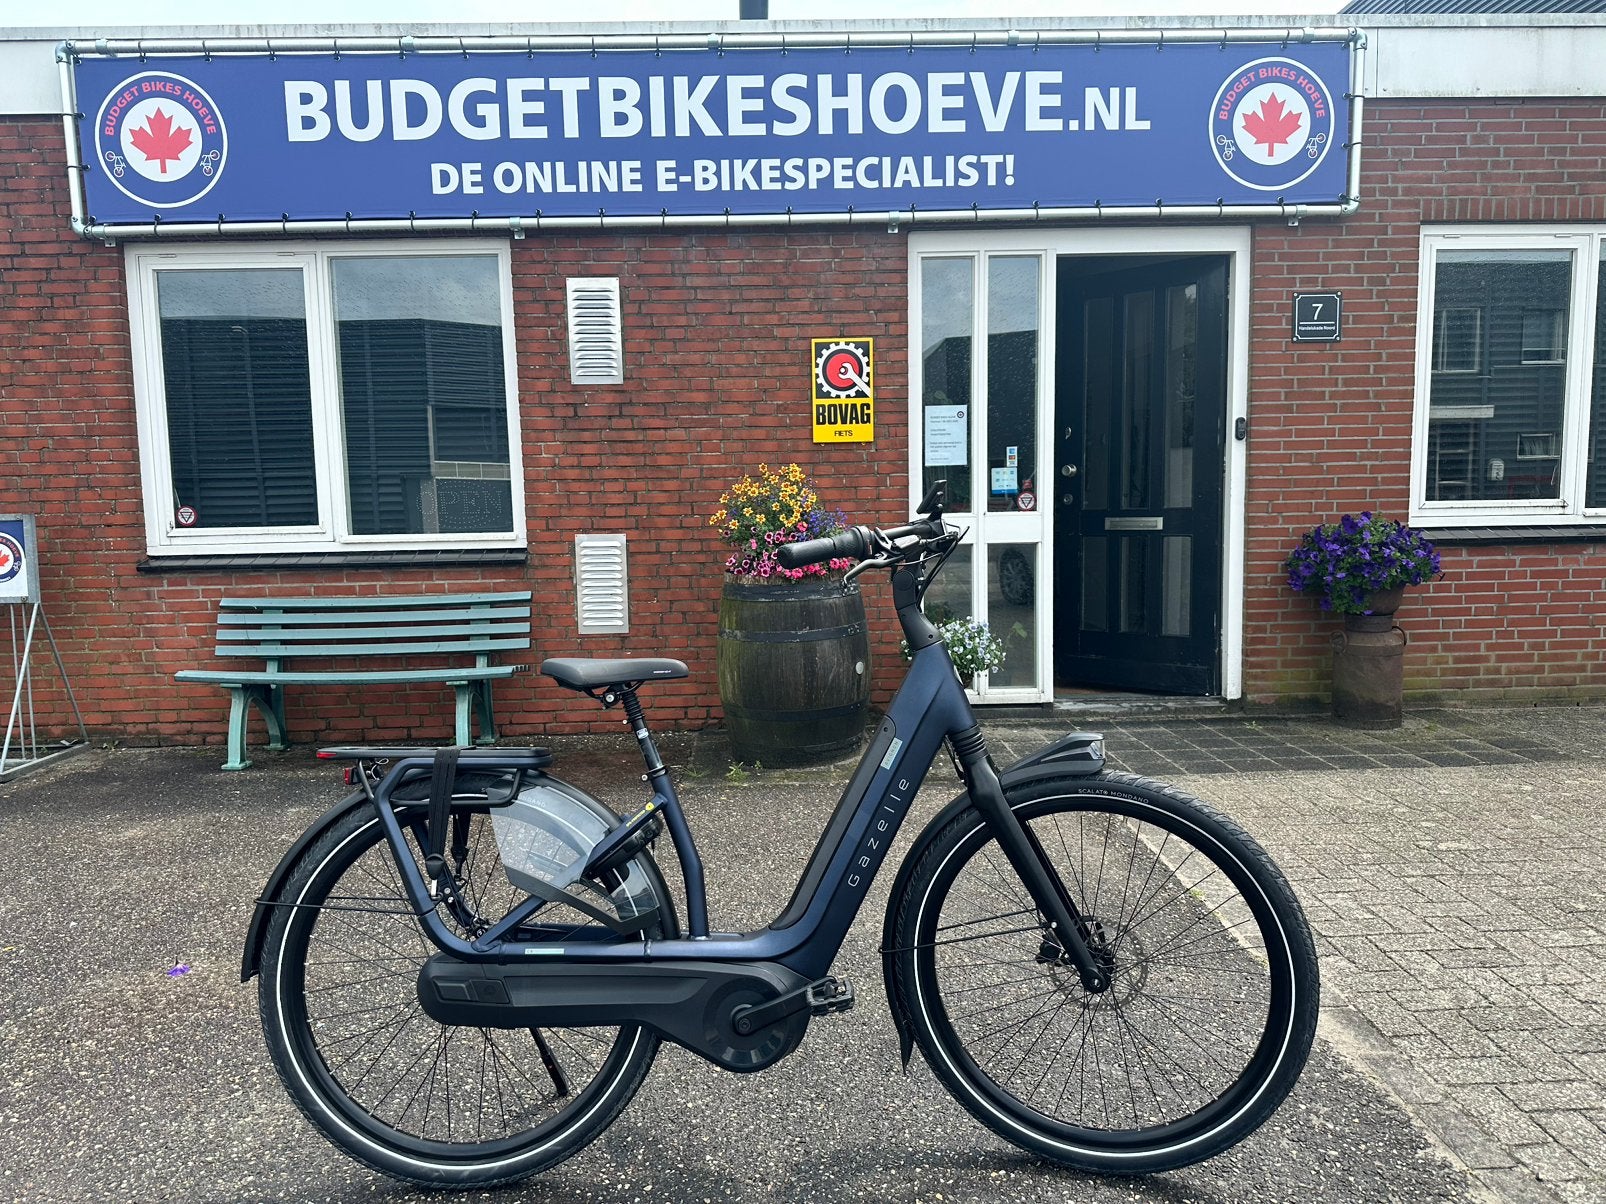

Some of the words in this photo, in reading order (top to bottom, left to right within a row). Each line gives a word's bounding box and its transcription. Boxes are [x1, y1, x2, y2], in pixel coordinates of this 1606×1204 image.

[105, 86, 139, 136] BUDGET
[141, 81, 182, 95] BIKES
[183, 90, 217, 135] HOEVE
[285, 71, 1151, 142] BUDGETBIKESHOEVE.NL
[1219, 72, 1255, 120] BUDGET
[1259, 67, 1297, 80] BIKES
[1297, 76, 1326, 118] HOEVE
[431, 162, 484, 195] DE
[493, 160, 643, 194] ONLINE
[656, 154, 1015, 192] E-BIKESPECIALIST!
[1311, 303, 1324, 321] 7
[815, 403, 871, 425] BOVAG
[847, 778, 910, 888] Gazelle
